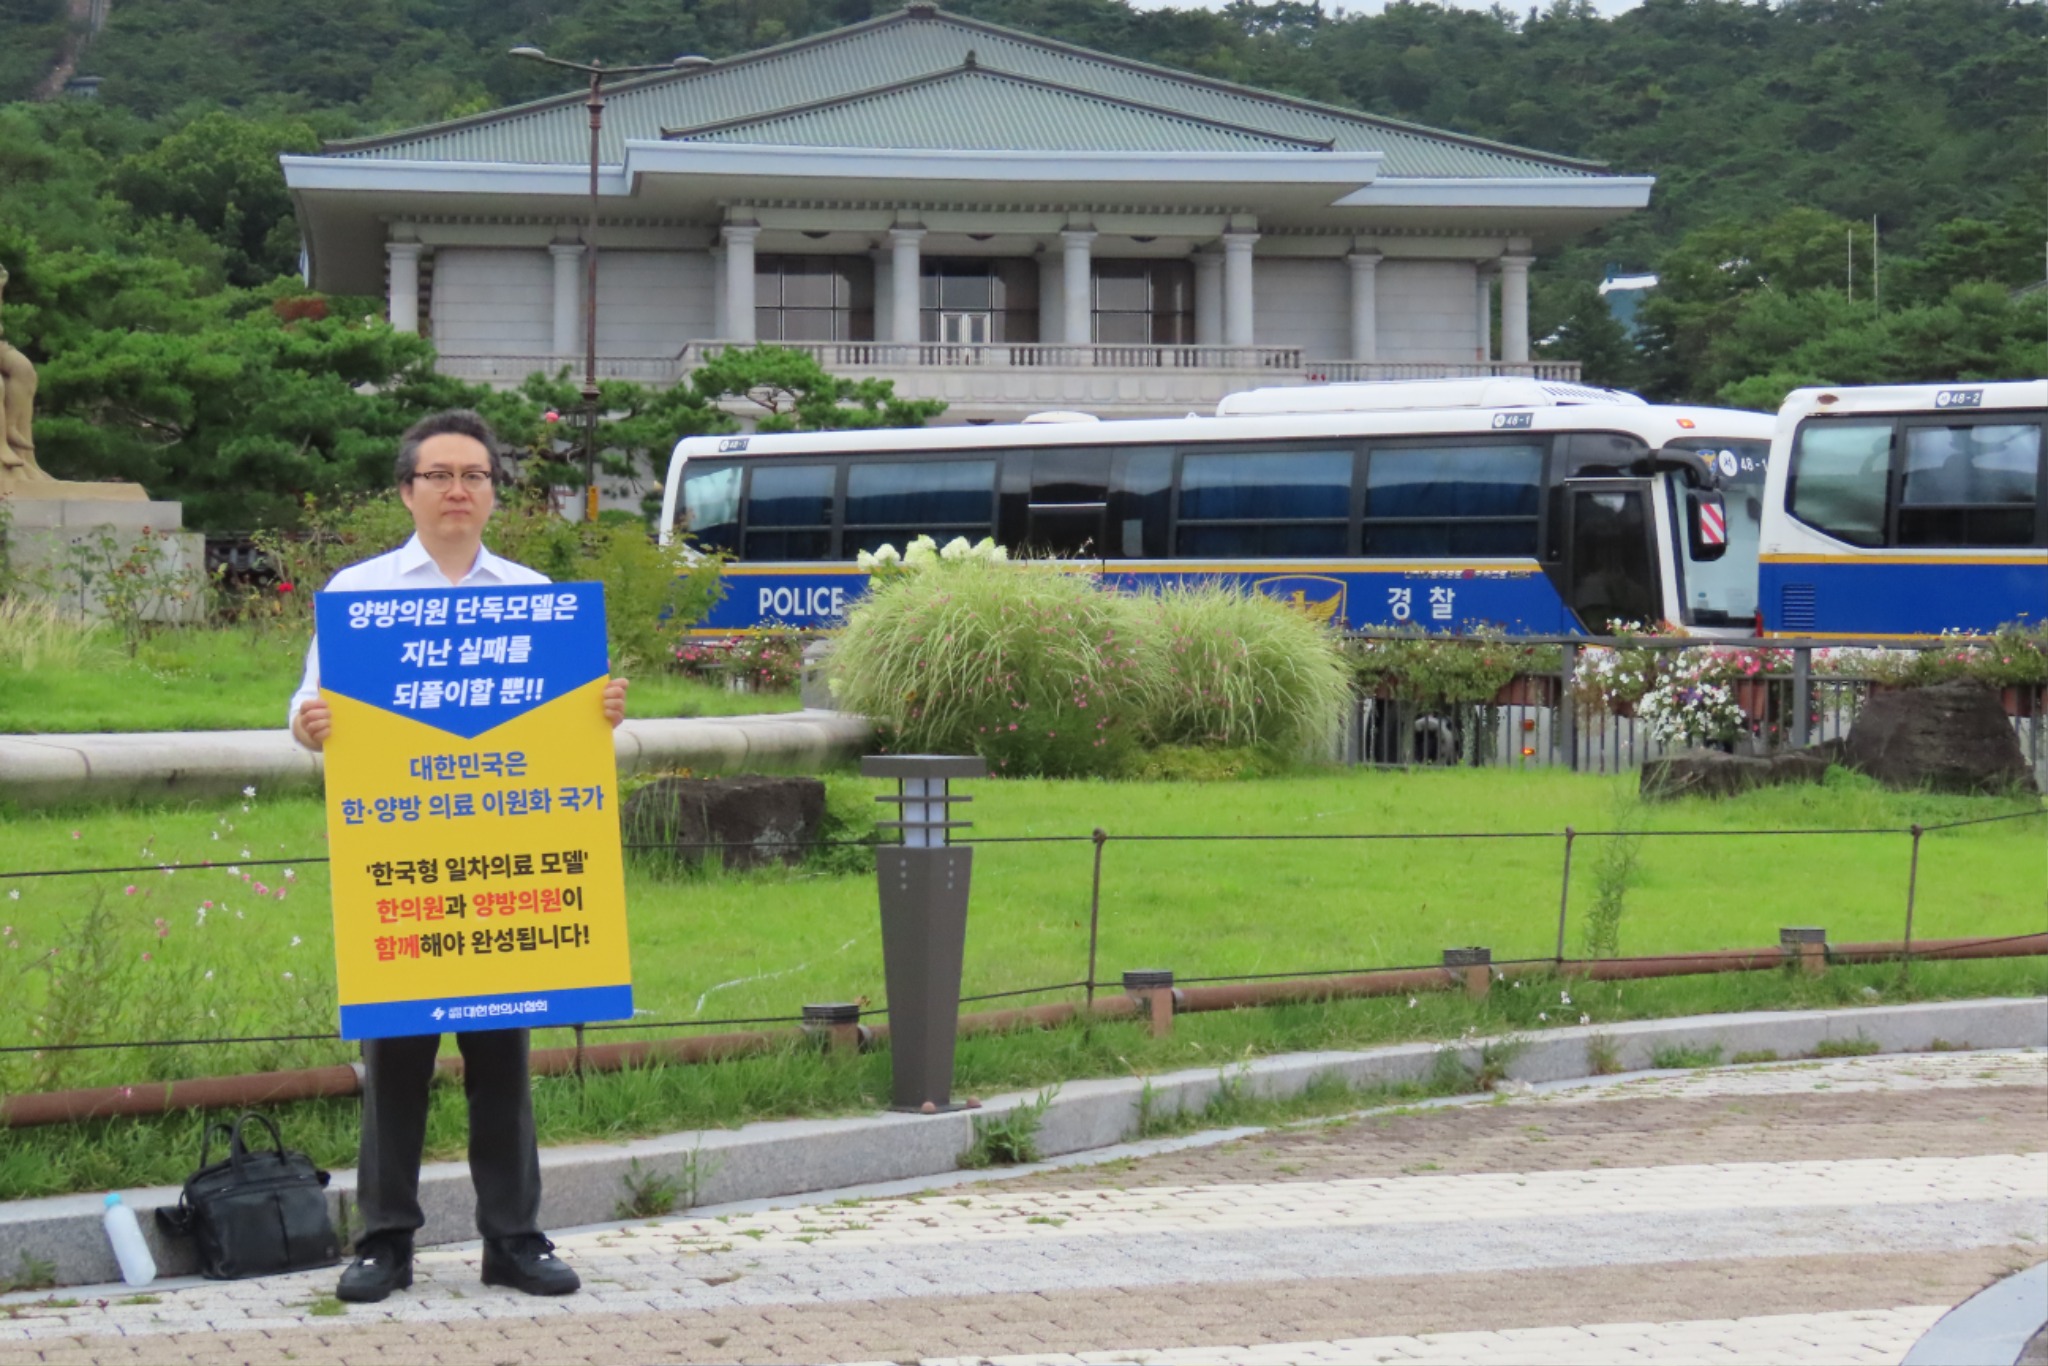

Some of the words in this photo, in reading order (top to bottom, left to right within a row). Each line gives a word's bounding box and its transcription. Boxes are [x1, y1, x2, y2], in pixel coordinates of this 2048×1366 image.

[349, 597, 449, 629] 양방의원
[455, 593, 578, 624] 단독모델은
[759, 586, 844, 616] POLICE
[400, 638, 452, 668] 지난
[458, 635, 532, 666] 실패를
[392, 677, 495, 709] 되풀이할
[499, 677, 544, 704] 뿐!!
[409, 751, 528, 781] 대한민국은
[428, 792, 476, 820] 의료
[481, 788, 552, 817] 이원화
[558, 785, 605, 812] 국가
[366, 857, 439, 887] '한국형
[445, 853, 535, 883] 일차의료
[540, 850, 589, 876] 모델'
[376, 893, 467, 924] 한의원과
[472, 886, 583, 919] 양방의원이
[374, 931, 466, 962] 함께해야
[471, 923, 590, 955] 완성됩니다!
